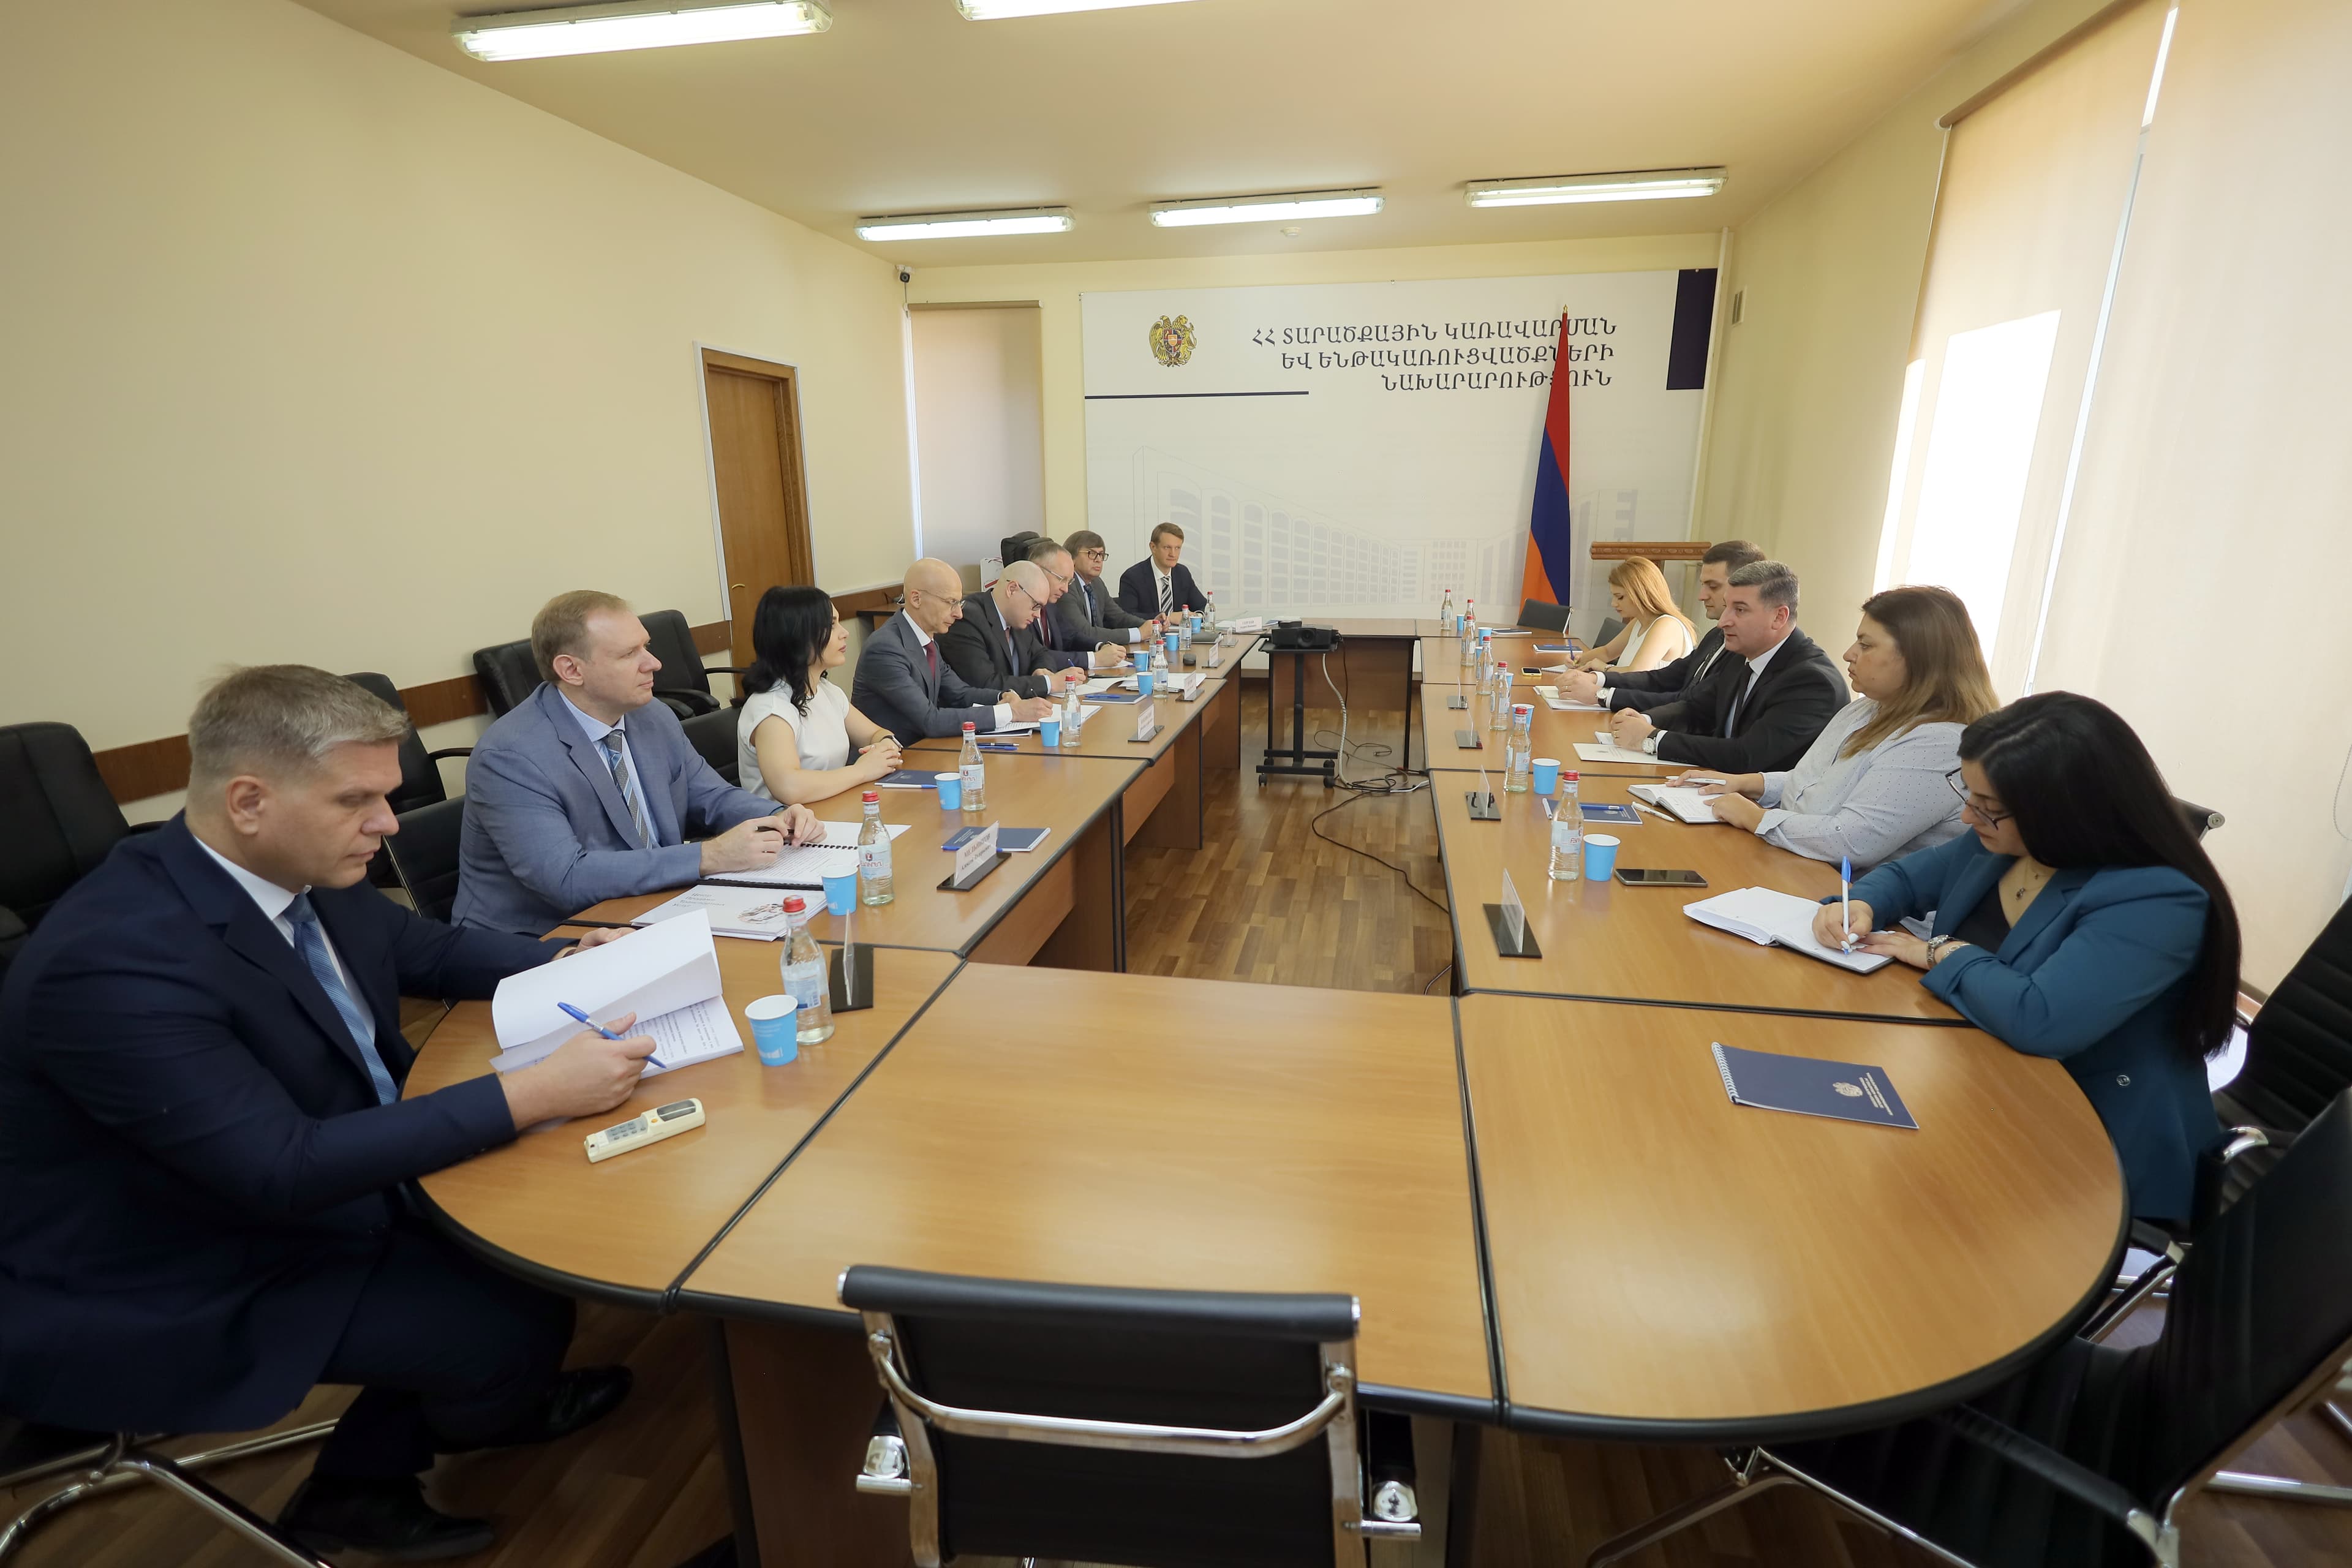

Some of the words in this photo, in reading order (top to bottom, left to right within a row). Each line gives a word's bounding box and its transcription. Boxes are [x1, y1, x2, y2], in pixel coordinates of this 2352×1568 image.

[1252, 327, 1276, 347] ՀՀ
[1283, 323, 1438, 345] ՏԱՐԱԾՔԱՅԻՆ
[1444, 317, 1618, 339] ԿԱՌԱՎԱՐՄԱՆ
[1281, 352, 1313, 370] ԵՎ
[1381, 368, 1613, 391] ՆԱԽԱՐԱՐՈՒԹՈՒՆ
